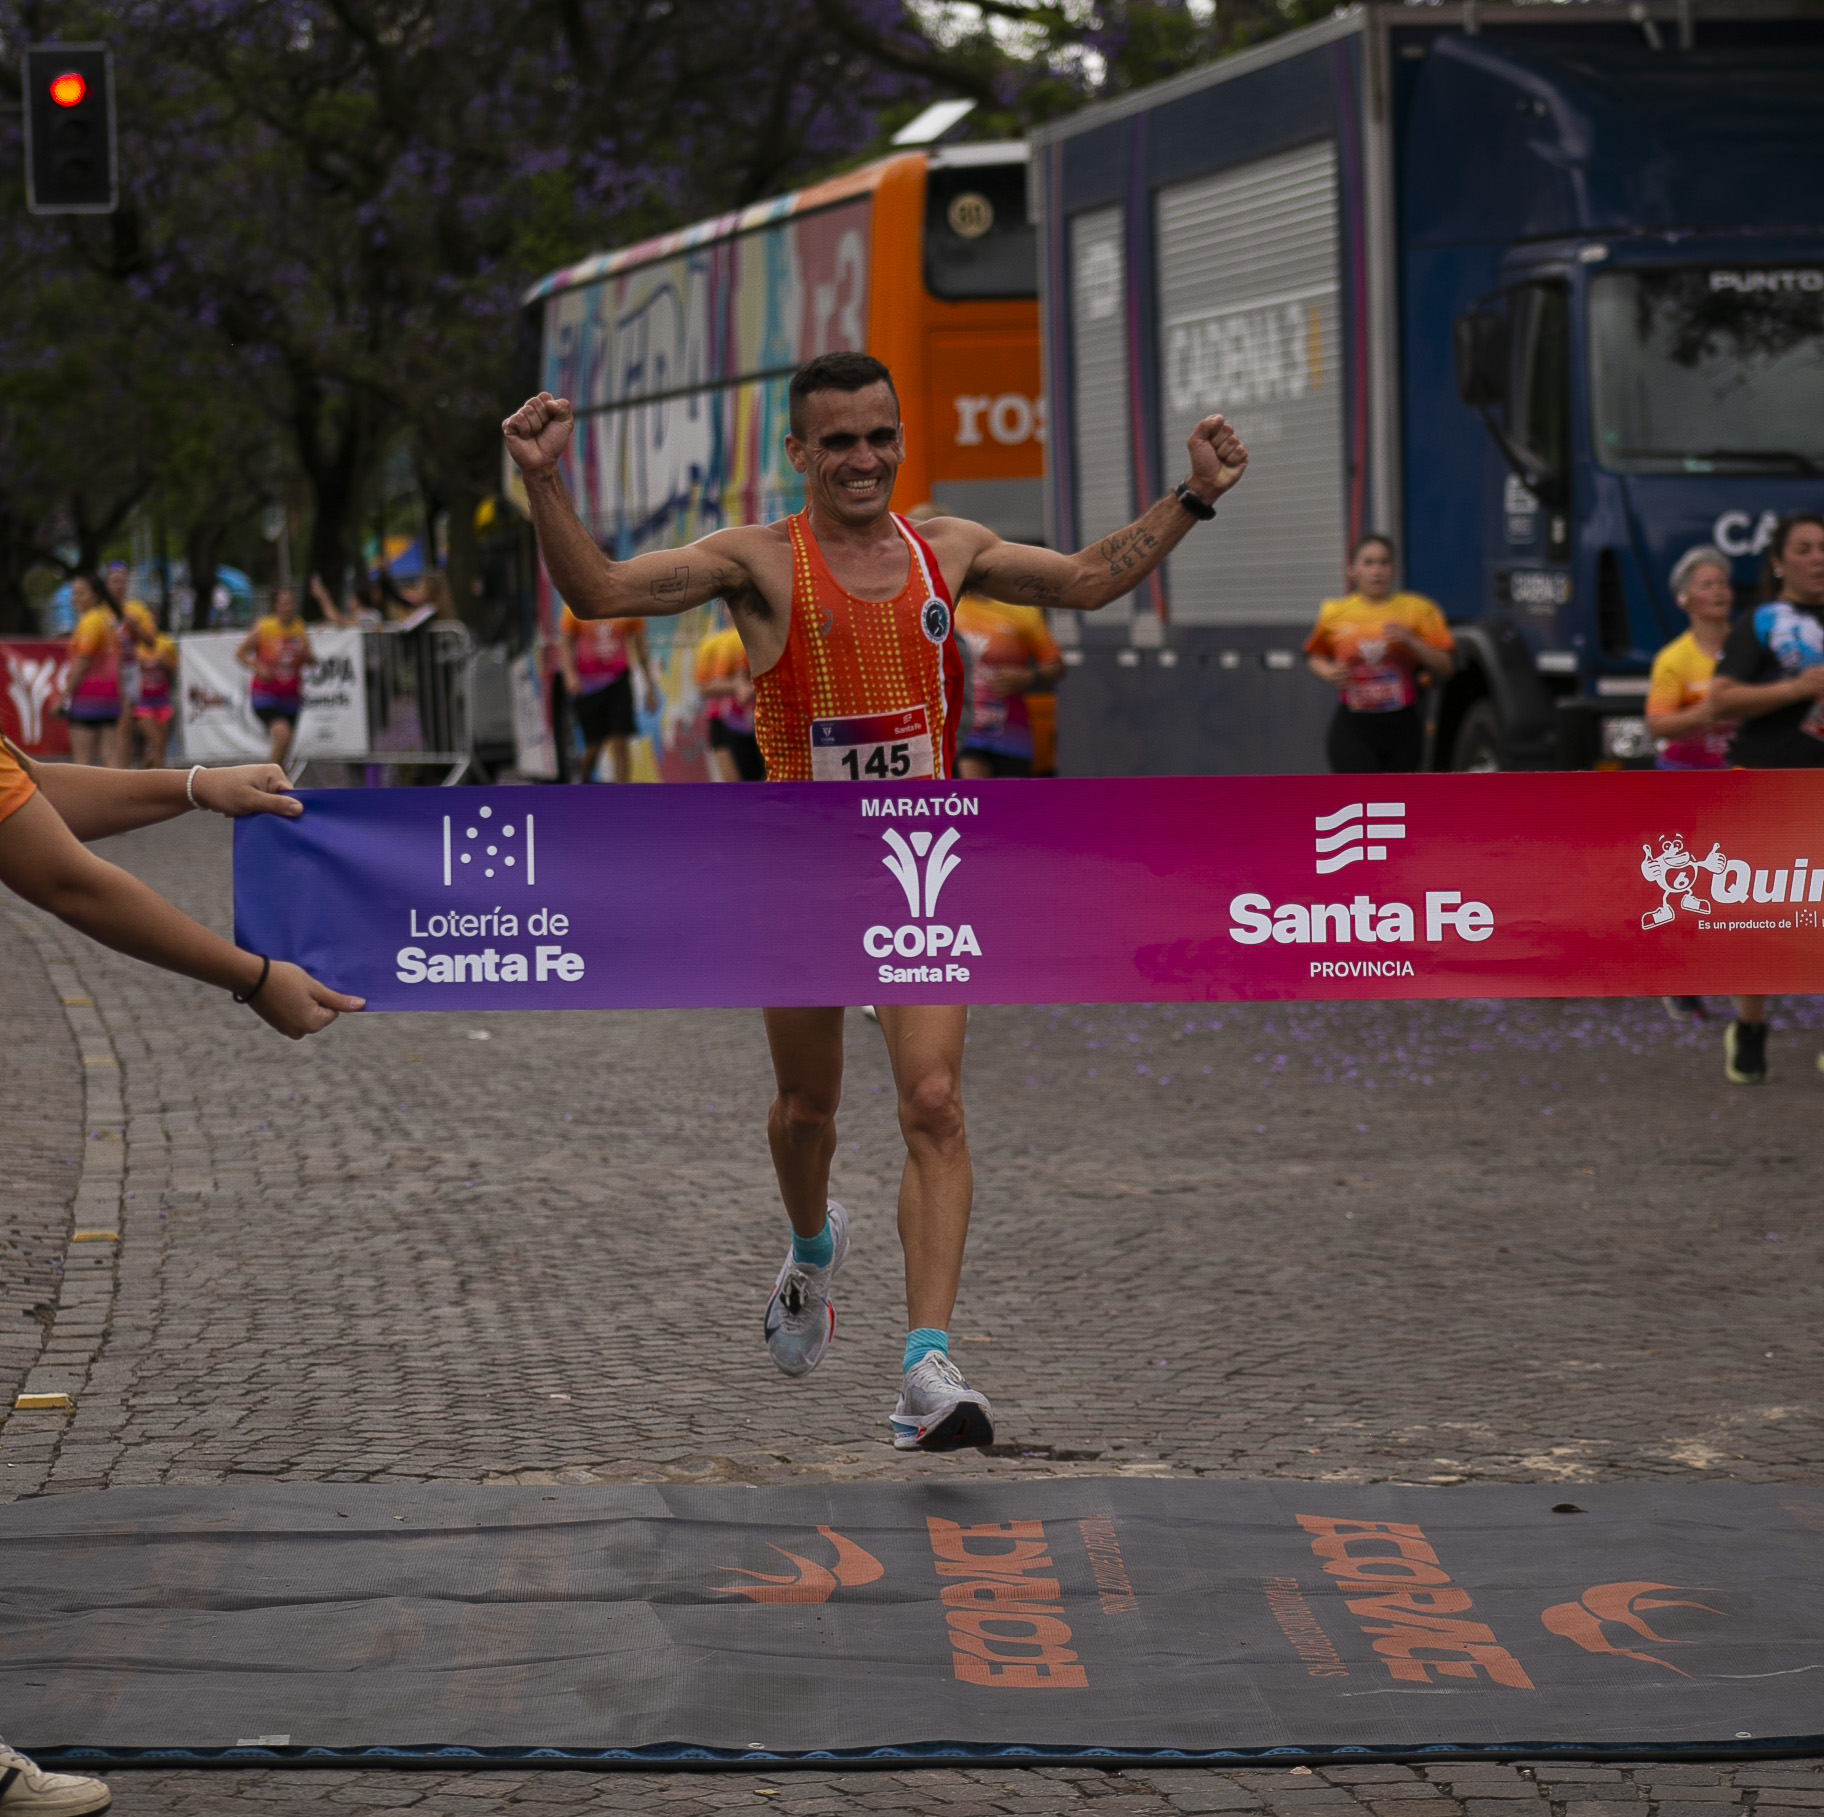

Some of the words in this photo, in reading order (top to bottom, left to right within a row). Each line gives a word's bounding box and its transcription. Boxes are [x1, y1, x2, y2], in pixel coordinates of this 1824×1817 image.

[1709, 271, 1824, 292] PUNTO
[894, 725, 915, 735] Santa
[914, 722, 923, 731] Fe
[841, 743, 911, 781] 145
[861, 793, 979, 817] MARATÓN
[410, 906, 519, 937] Lotería
[527, 907, 570, 936] de
[1229, 893, 1415, 945] Santa
[1425, 891, 1494, 942] Fe
[1698, 920, 1711, 930] Es
[1713, 922, 1726, 930] un
[1728, 919, 1775, 931] producto
[1778, 919, 1792, 929] de
[863, 924, 983, 958] COPA
[396, 947, 529, 984] Santa
[535, 945, 585, 982] Fe
[878, 964, 943, 983] Santa
[945, 964, 970, 982] Fe
[1310, 961, 1415, 977] PROVINCIA
[926, 1515, 1089, 1688] ECORACE
[1294, 1513, 1536, 1690] ECORACE
[1286, 1633, 1350, 1678] DEPORTAS
